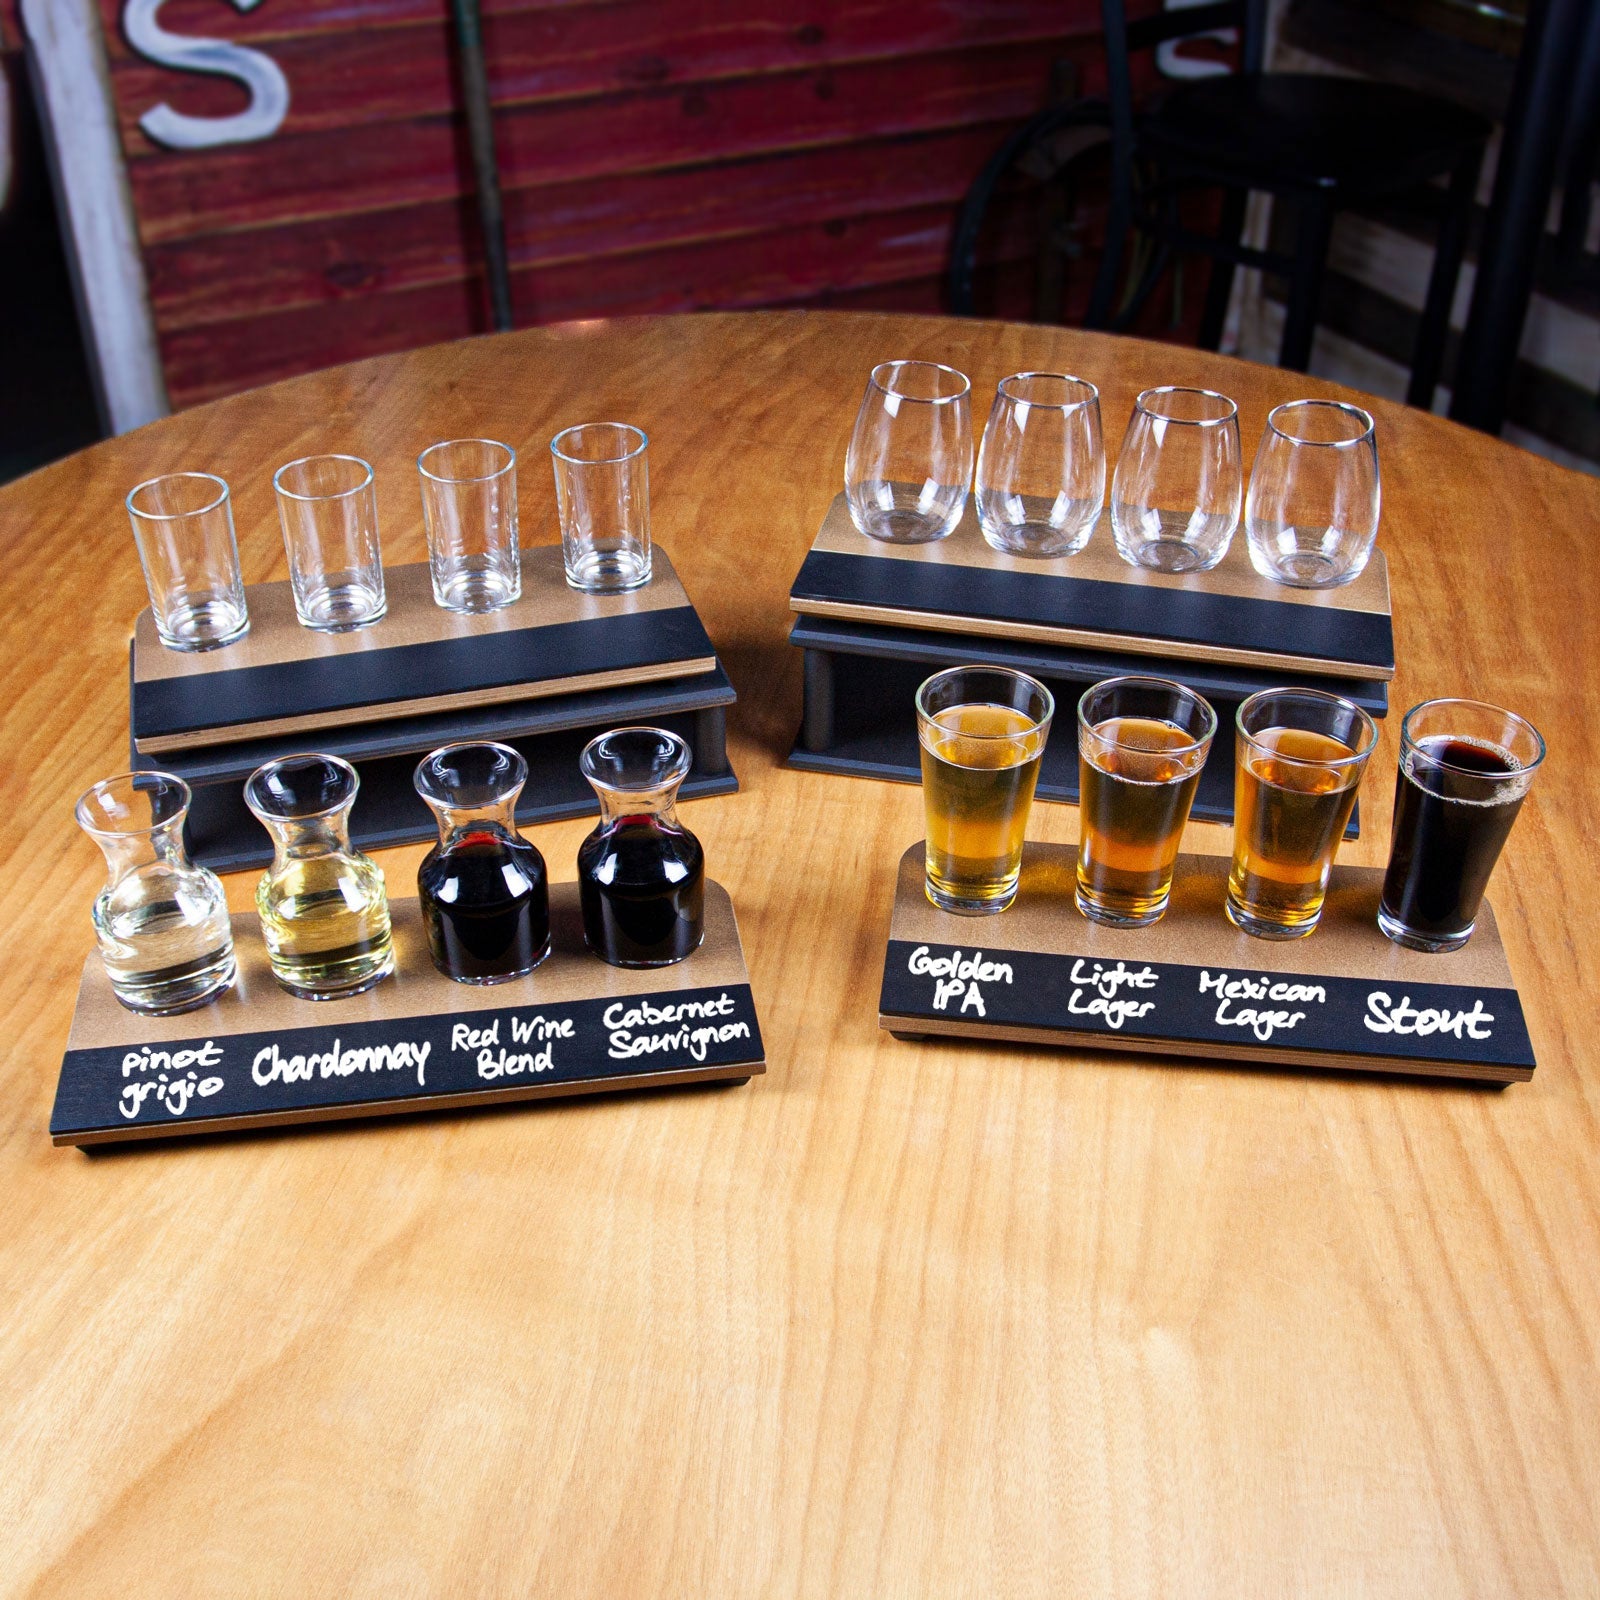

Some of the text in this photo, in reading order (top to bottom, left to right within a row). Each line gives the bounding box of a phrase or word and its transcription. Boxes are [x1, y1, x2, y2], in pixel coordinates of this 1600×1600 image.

[908, 946, 1013, 984] Golden
[1070, 959, 1159, 998] Light
[933, 979, 986, 1017] IPA
[1198, 970, 1326, 1003] Mexican
[603, 993, 735, 1030] Cabernet
[1068, 989, 1156, 1029] Lager
[1215, 999, 1306, 1041] Lager
[1363, 991, 1495, 1040] Stout
[451, 1016, 576, 1051] Red Wine
[608, 1022, 750, 1061] Sauvignon
[121, 1041, 224, 1077] pinot
[251, 1039, 432, 1087] Chardonnay
[477, 1042, 554, 1080] Blend
[118, 1072, 225, 1118] grigio
